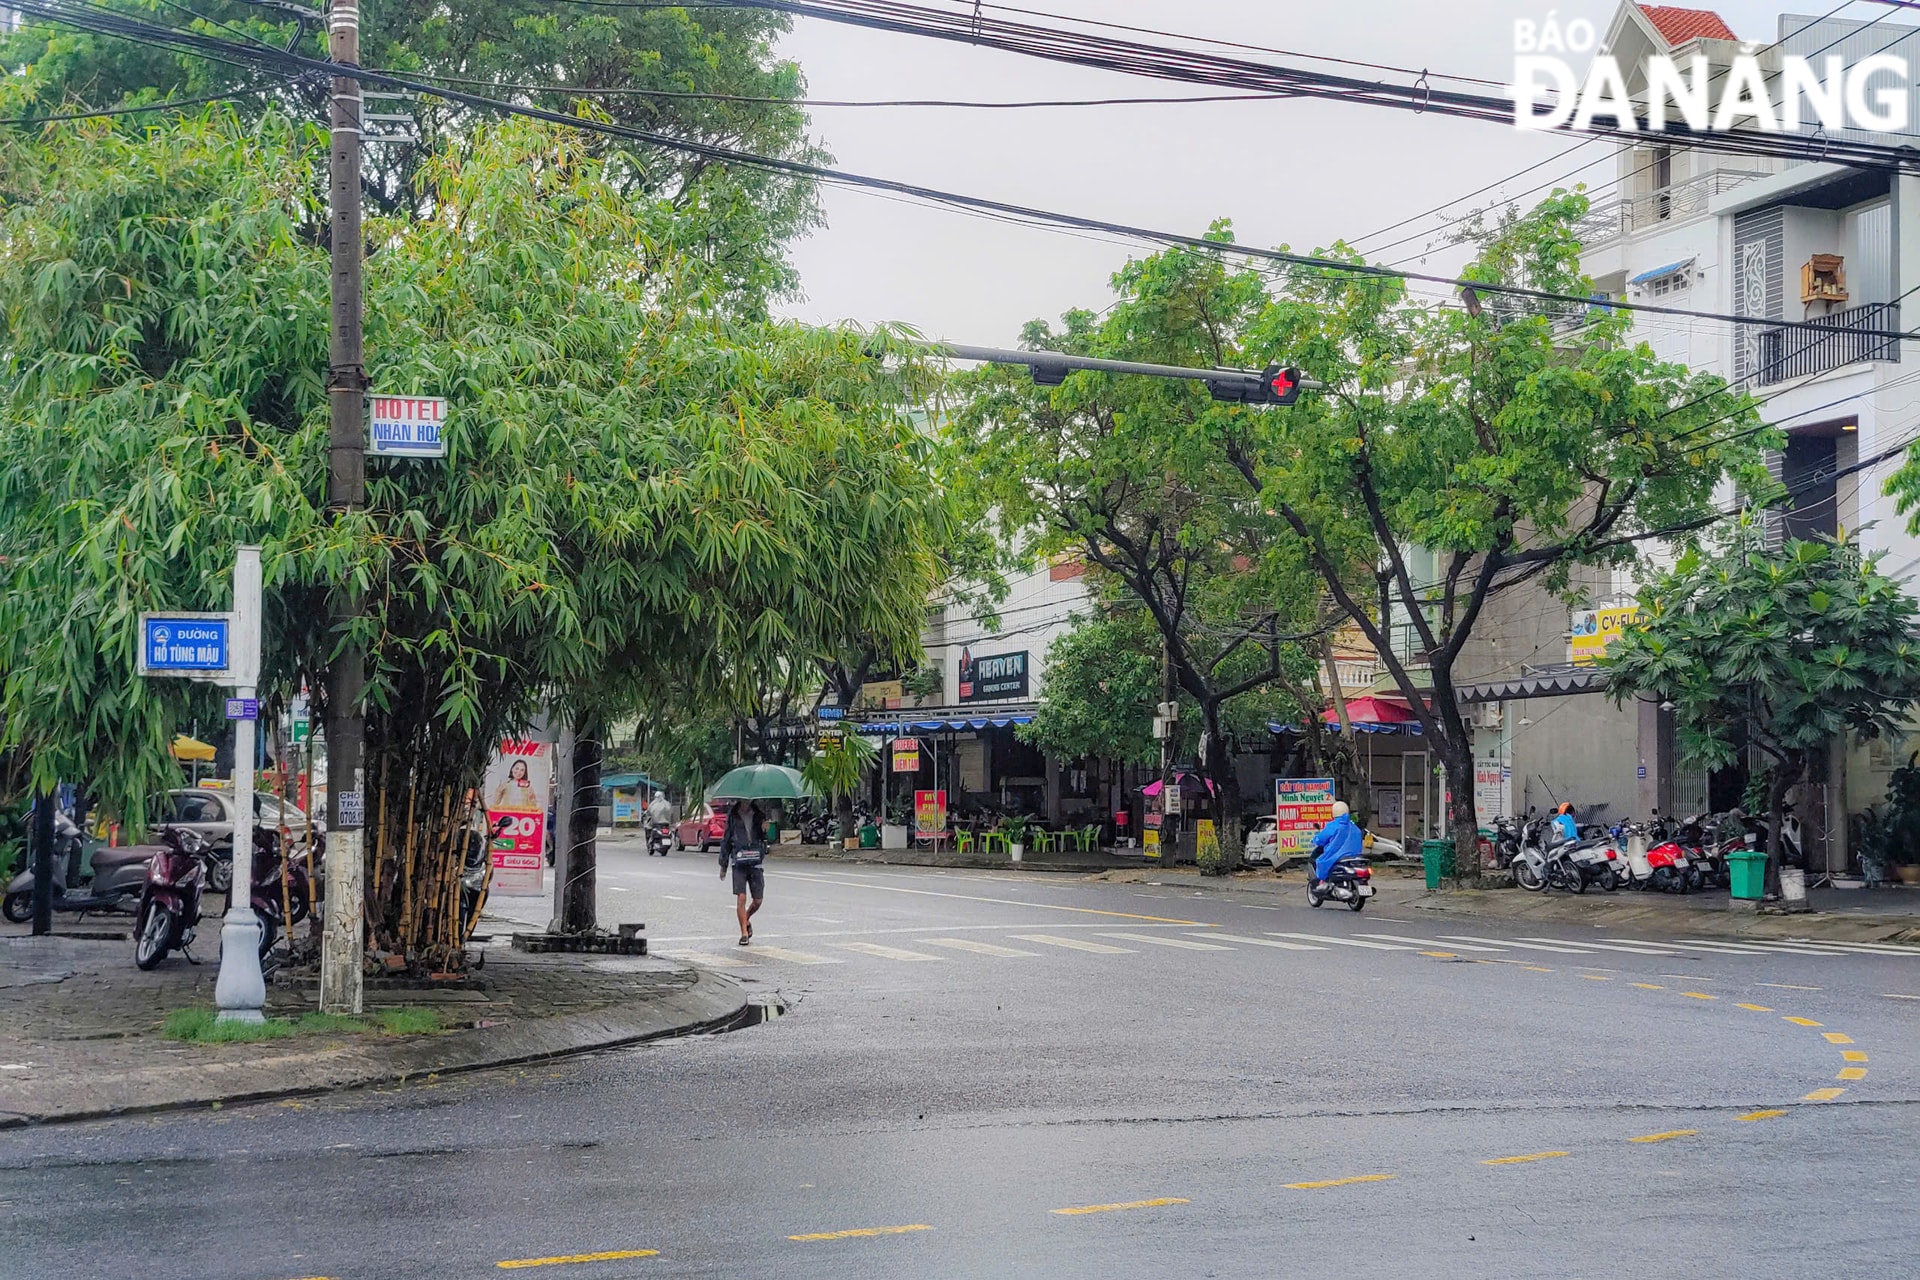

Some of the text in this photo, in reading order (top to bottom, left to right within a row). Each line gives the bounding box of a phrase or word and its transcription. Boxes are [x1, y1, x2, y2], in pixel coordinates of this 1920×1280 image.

[375, 398, 442, 421] HOTEL
[374, 421, 411, 441] NHÂN
[177, 627, 218, 640] ĐƯỜNG
[154, 642, 219, 666] HỒ TÙNG MẬU
[978, 654, 1024, 681] HEAVEN
[1001, 681, 1021, 691] CENTER
[1281, 793, 1331, 803] Minh Nguyệt 2
[1279, 808, 1297, 820] NAM
[1281, 834, 1297, 849] NỮ
